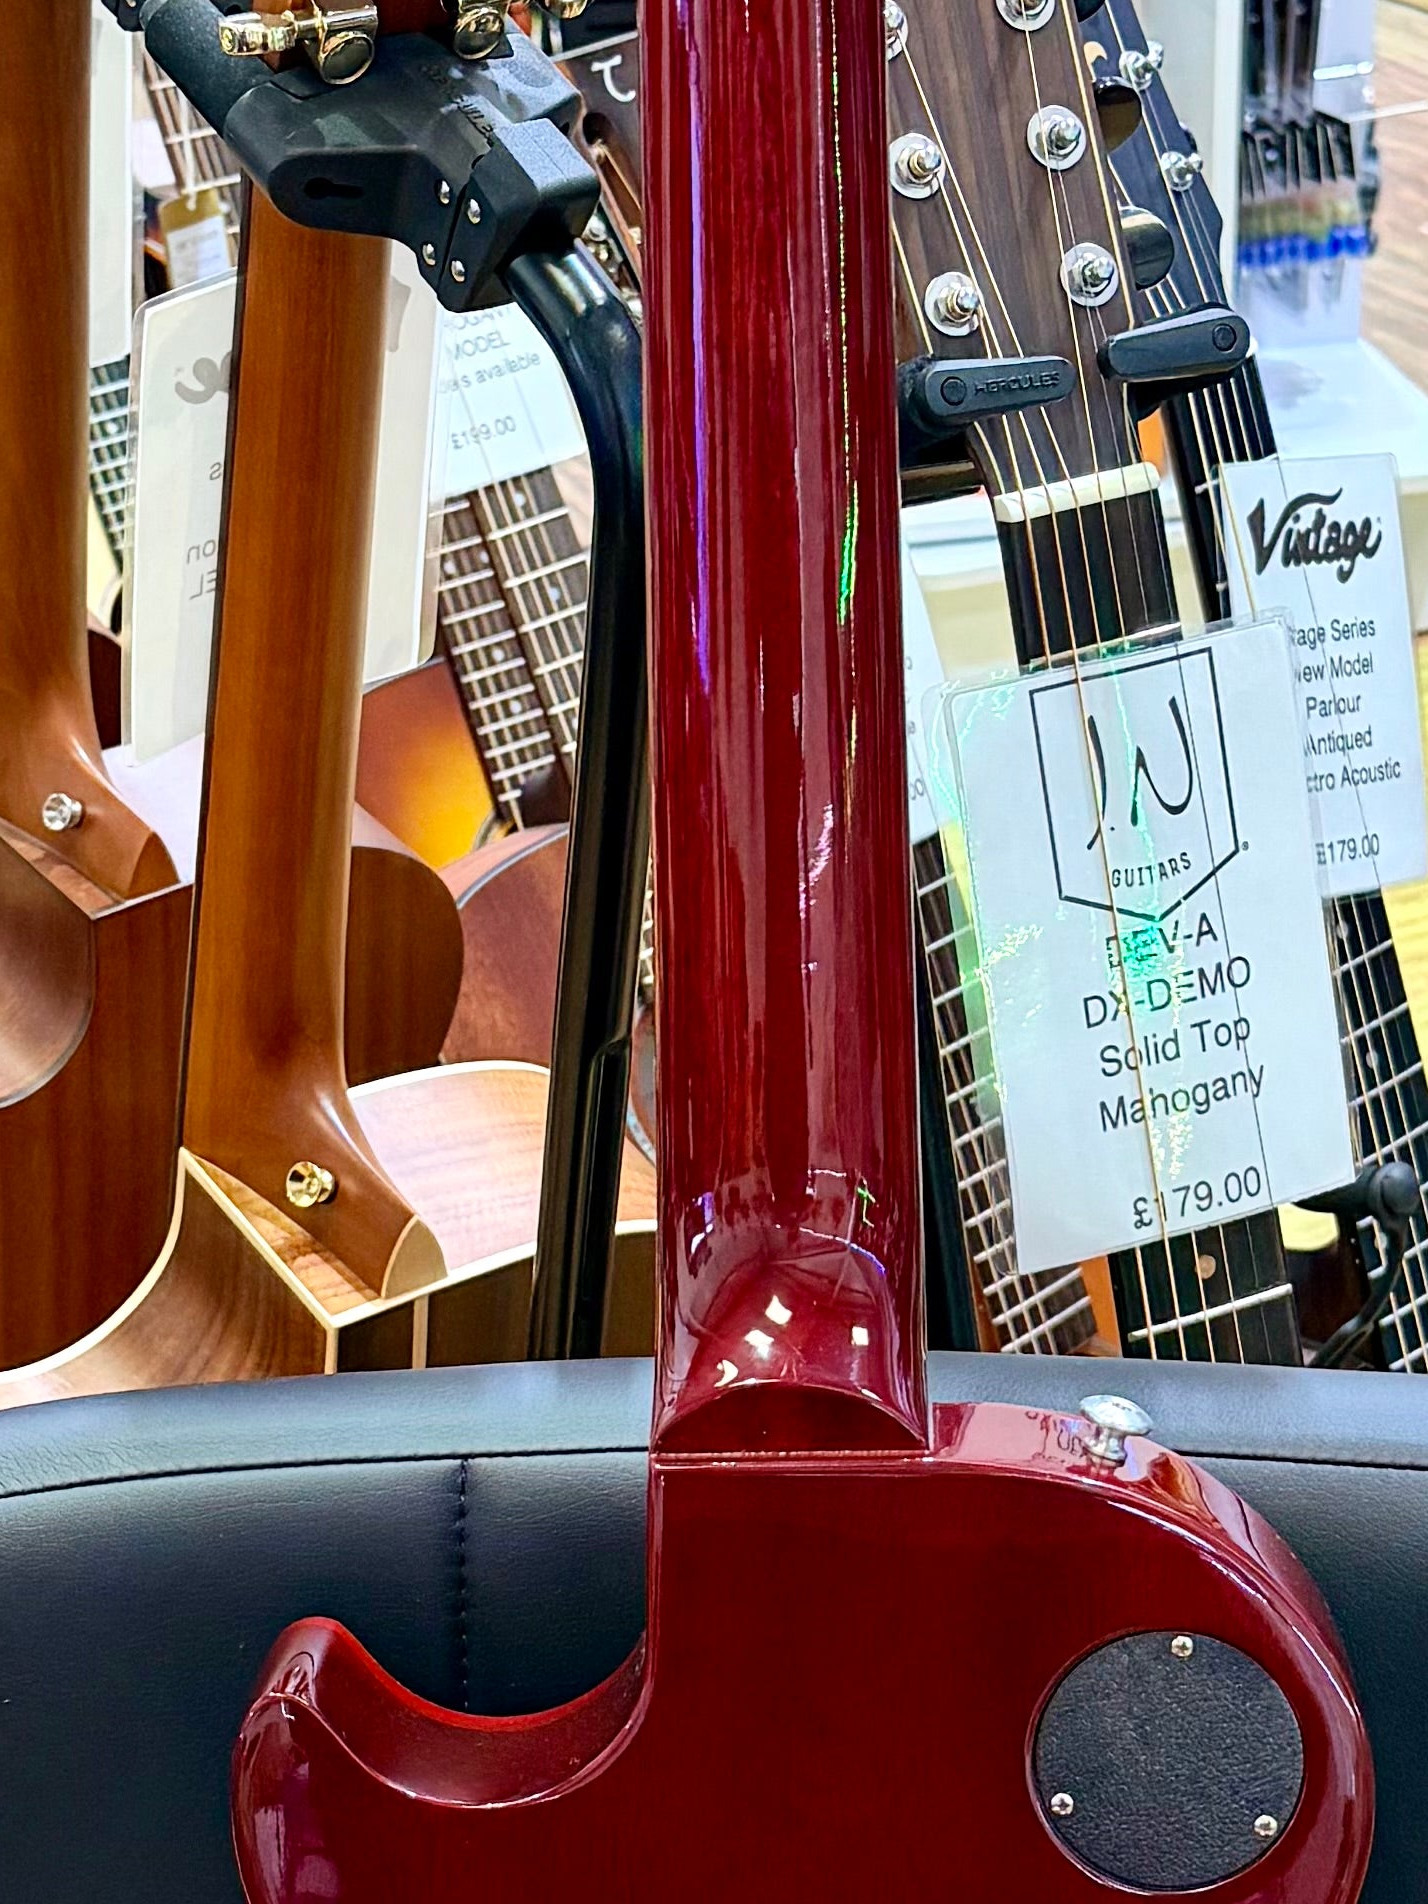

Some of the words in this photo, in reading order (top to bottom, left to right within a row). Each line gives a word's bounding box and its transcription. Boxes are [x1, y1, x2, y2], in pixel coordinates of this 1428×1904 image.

[475, 351, 542, 385] available
[974, 371, 1061, 397] HERCULES
[1246, 487, 1383, 584] Vintage
[1329, 616, 1376, 643] Series
[1329, 651, 1374, 680] Model
[1305, 693, 1362, 720] Parlour
[1304, 725, 1373, 759] Antiqued
[1339, 757, 1402, 788] Acoustic
[1111, 851, 1192, 889] GUITARS
[1083, 955, 1251, 1029] DX-DEMO
[1099, 1034, 1181, 1079] Solid
[1190, 1016, 1252, 1055] Top
[1099, 1064, 1265, 1133] Mahogany
[1132, 1166, 1262, 1230] £179.00
